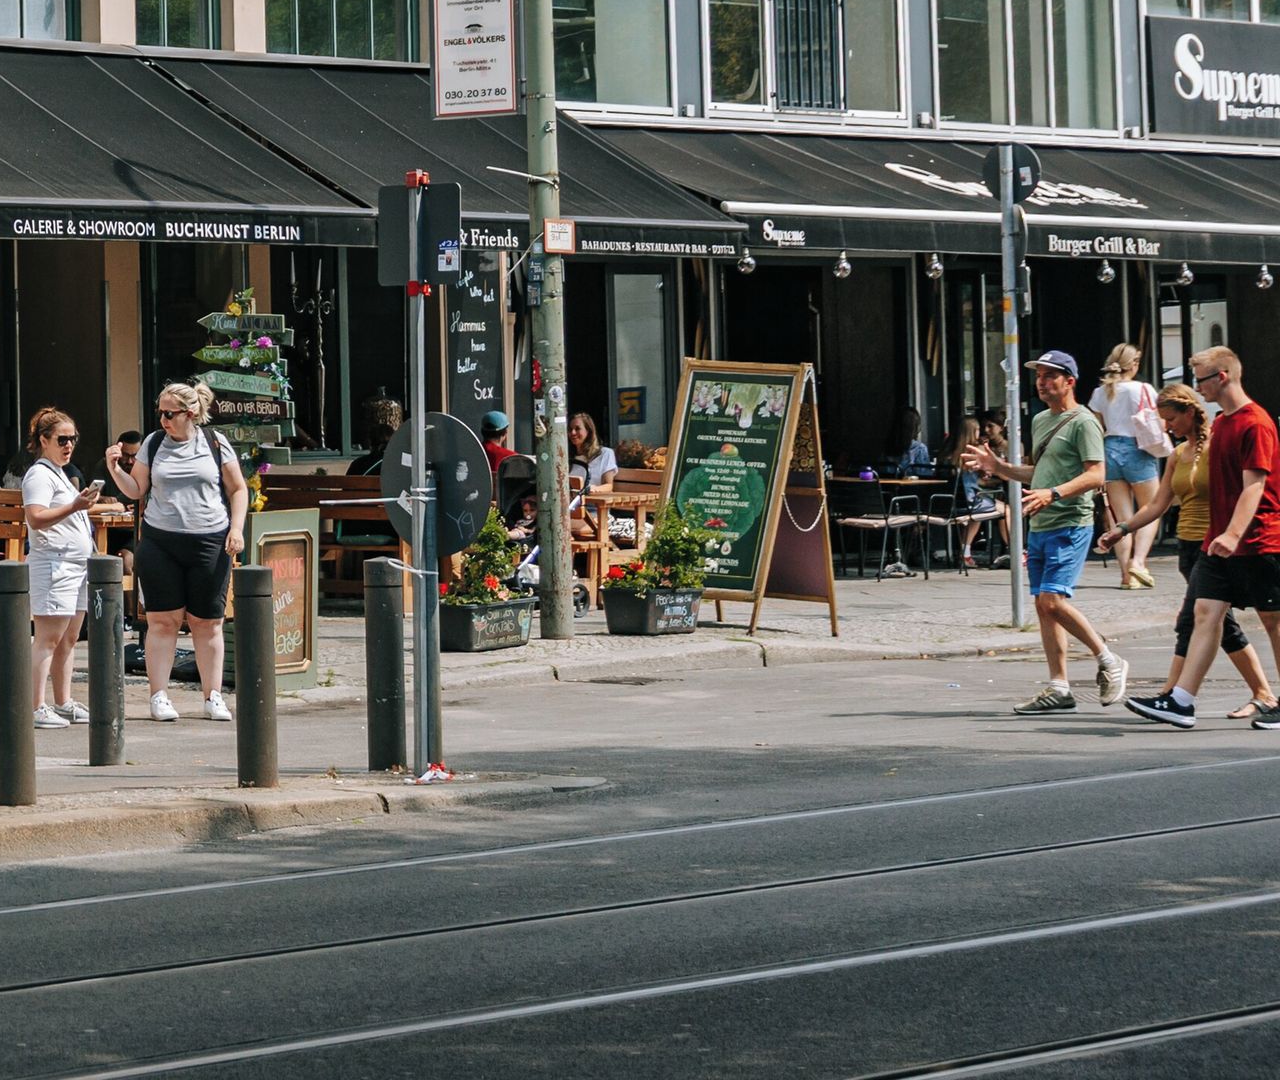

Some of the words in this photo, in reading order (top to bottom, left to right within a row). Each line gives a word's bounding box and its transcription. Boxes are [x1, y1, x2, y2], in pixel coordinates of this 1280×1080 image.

[444, 37, 467, 46] ENGEL
[473, 34, 506, 44] VÖLKERS
[482, 88, 492, 97] 37
[495, 87, 507, 96] 80
[13, 219, 64, 235] GALERIE
[67, 221, 76, 235] &
[80, 221, 156, 237] SHOWROOM
[165, 222, 250, 239] BUCHKUNST
[254, 224, 301, 241] BERLIN
[470, 228, 519, 248] Friends
[763, 219, 806, 247] Supreme
[581, 240, 631, 251] BAHADUNES
[635, 241, 685, 253] RESTAURANT
[691, 243, 707, 254] BAR
[1048, 234, 1092, 256] Burger
[1093, 236, 1123, 255] Grill
[1125, 238, 1136, 255] &
[1137, 239, 1160, 256] Bar
